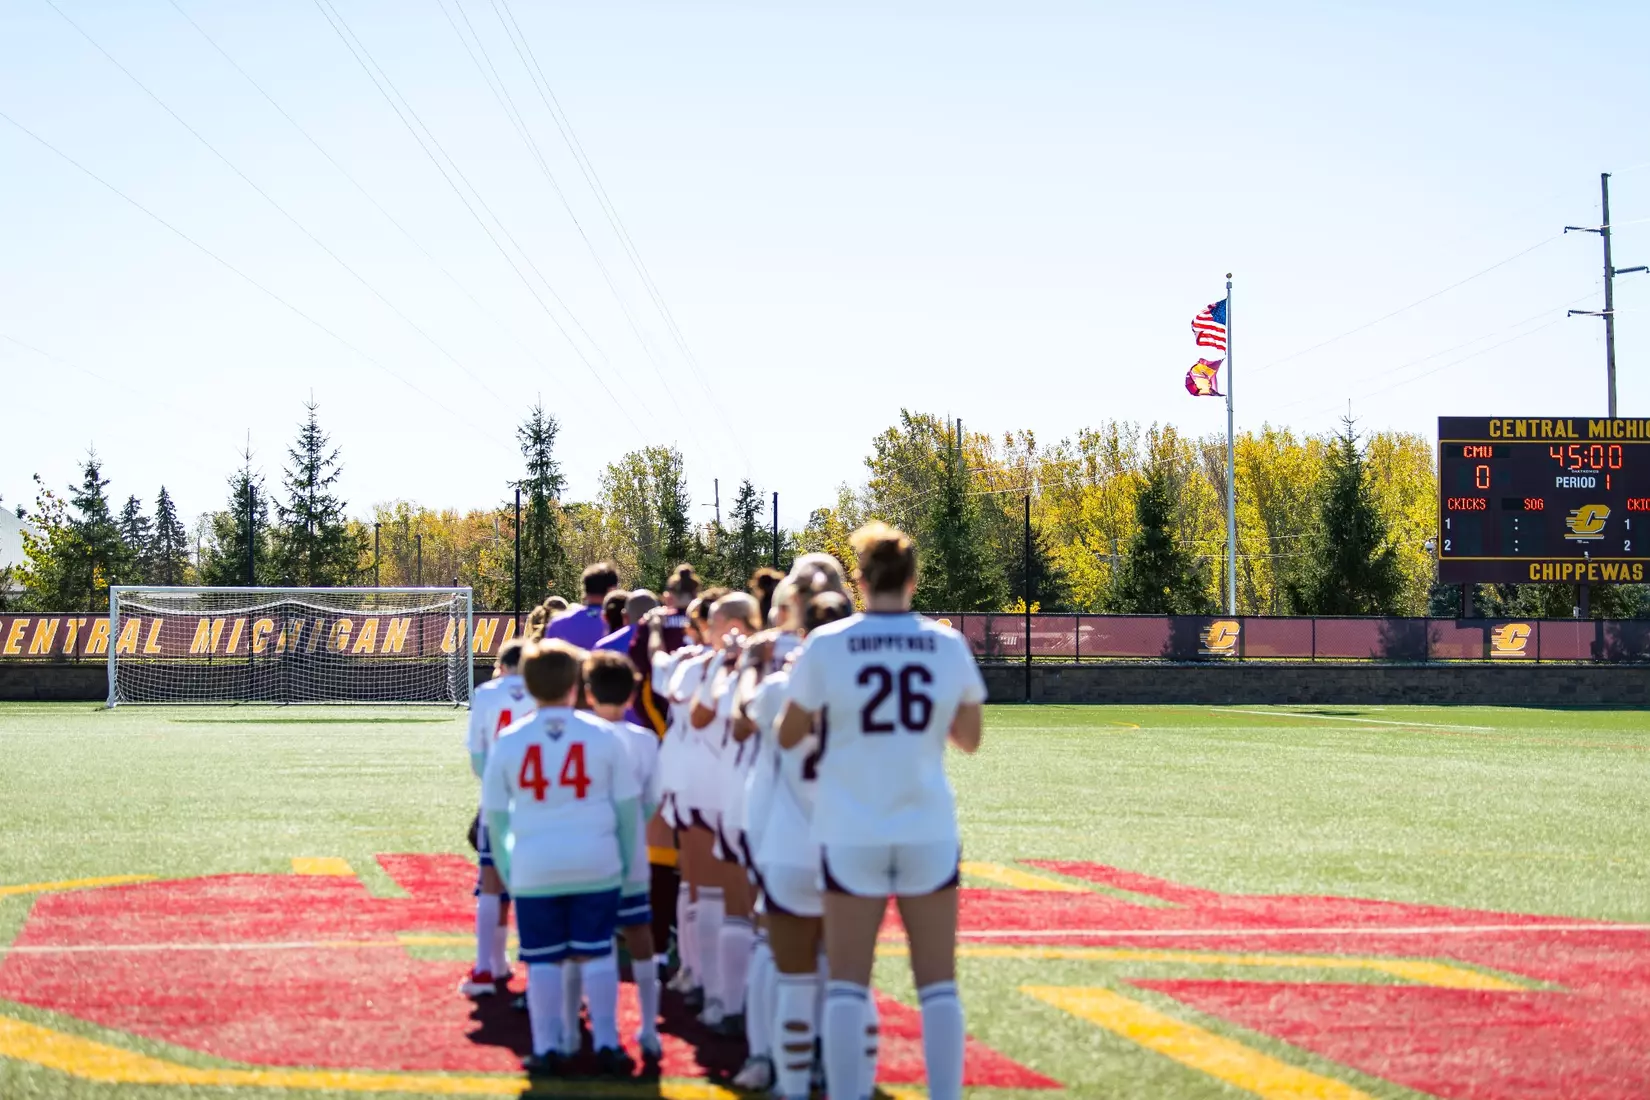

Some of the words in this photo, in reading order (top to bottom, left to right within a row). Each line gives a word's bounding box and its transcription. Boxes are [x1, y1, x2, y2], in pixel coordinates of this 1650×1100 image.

[1489, 419, 1579, 438] CENTRAL
[1463, 445, 1493, 459] CMU
[1549, 444, 1623, 469] 45:00
[1475, 464, 1491, 490] 0
[1555, 476, 1596, 489] PERIOD
[1605, 473, 1611, 491] 1
[1447, 498, 1487, 511] CKICKS
[1523, 499, 1545, 511] SOG
[1444, 518, 1451, 530] 1
[1624, 518, 1631, 530] 1
[1444, 540, 1452, 551] 2
[1624, 540, 1631, 551] 2
[1529, 563, 1644, 581] CHIPPEWAS
[0, 618, 164, 654] ENTRAL
[189, 618, 412, 654] MICHIGAN
[440, 618, 533, 653] UNI
[857, 664, 933, 735] 26
[518, 741, 591, 801] 44
